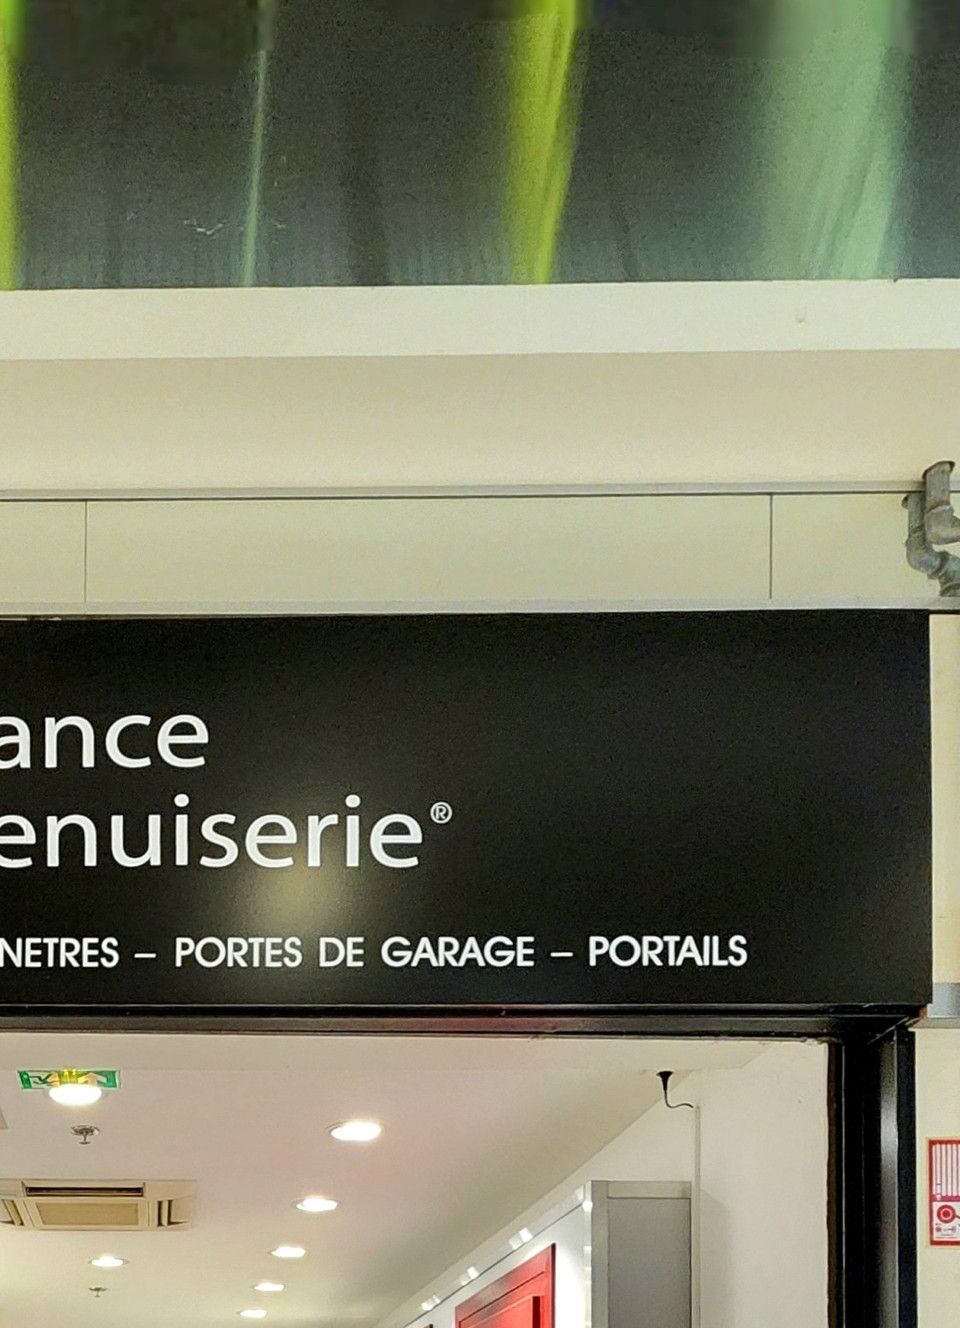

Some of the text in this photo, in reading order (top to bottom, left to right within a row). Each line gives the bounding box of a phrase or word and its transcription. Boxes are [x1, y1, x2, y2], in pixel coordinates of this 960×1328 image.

[175, 936, 303, 968] PORTES
[319, 936, 365, 968] DE
[381, 935, 535, 968] GARAGE
[589, 934, 748, 967] PORTAILS
